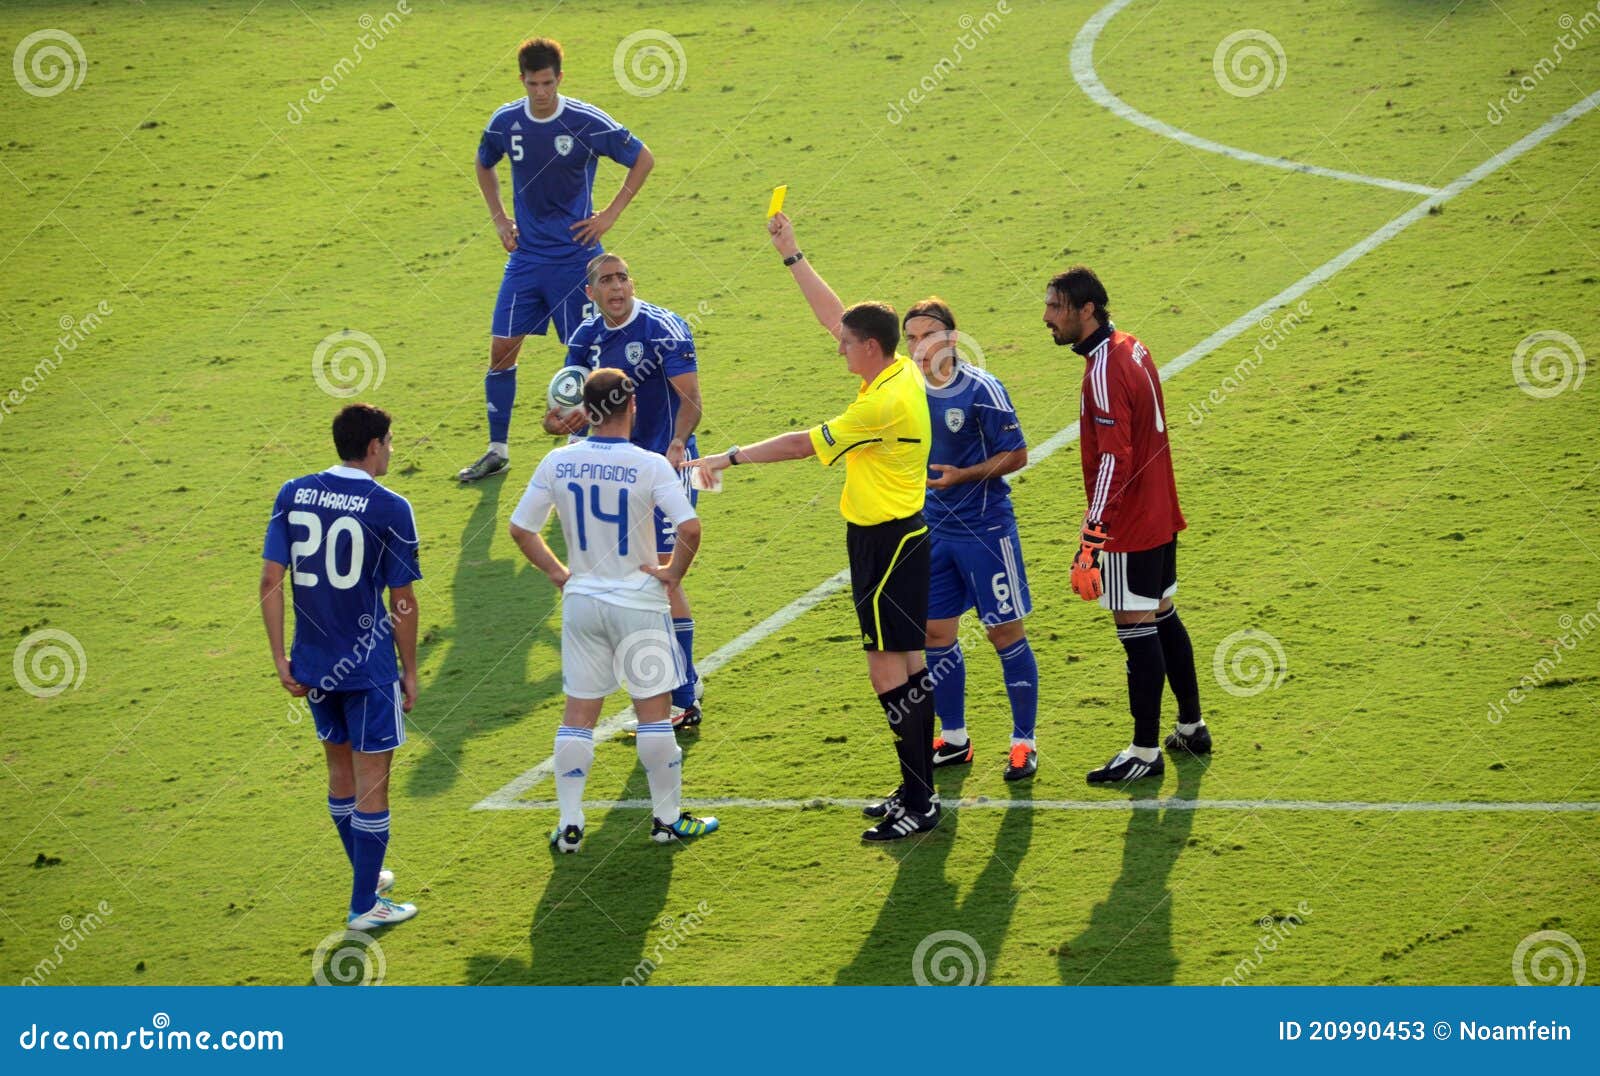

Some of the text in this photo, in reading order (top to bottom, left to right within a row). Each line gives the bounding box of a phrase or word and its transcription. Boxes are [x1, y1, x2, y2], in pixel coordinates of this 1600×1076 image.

[511, 135, 524, 161] 5
[556, 463, 638, 484] SALPINGIDIS
[294, 488, 369, 513] BEN HARUSH
[567, 481, 629, 556] 14
[288, 511, 365, 590] 20
[991, 572, 1010, 601] 6
